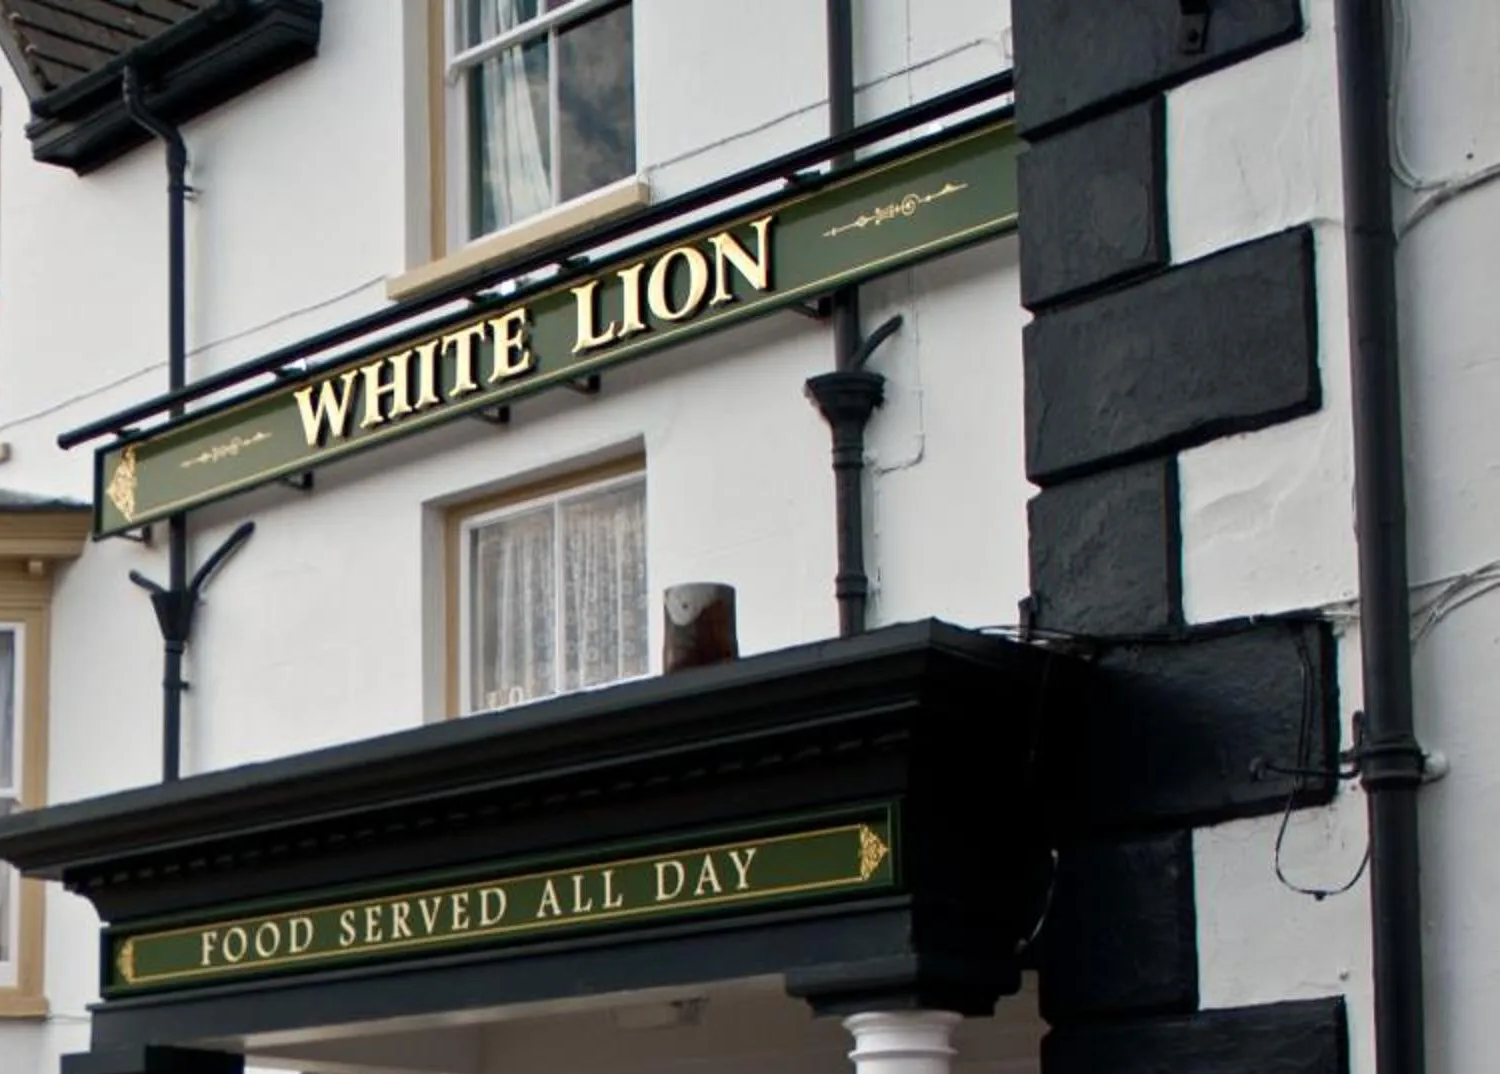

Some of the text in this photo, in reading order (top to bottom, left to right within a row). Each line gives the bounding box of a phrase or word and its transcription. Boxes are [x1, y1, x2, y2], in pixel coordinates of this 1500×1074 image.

[294, 215, 777, 447] WHITE LION
[200, 848, 758, 967] FOOD SERVED ALL DAY
